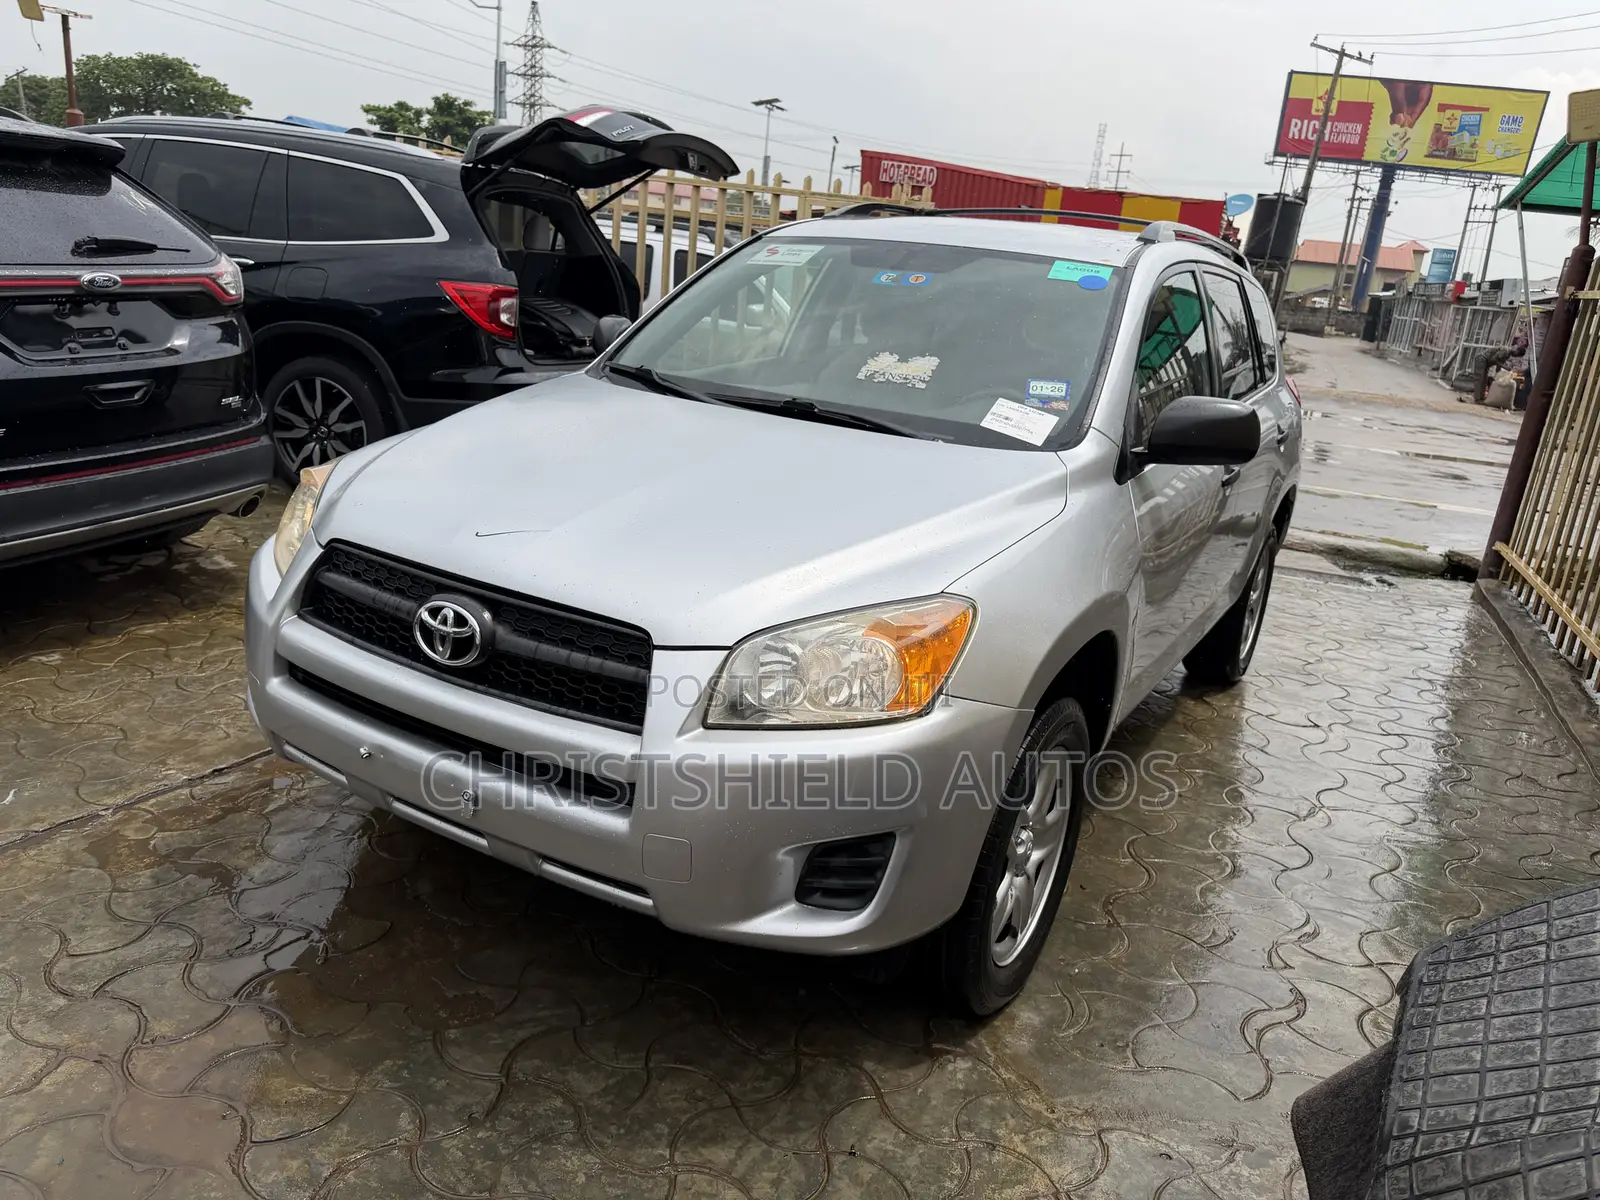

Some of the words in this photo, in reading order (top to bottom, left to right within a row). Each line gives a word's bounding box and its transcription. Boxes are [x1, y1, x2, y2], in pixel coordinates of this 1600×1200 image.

[611, 124, 634, 137] PILOT
[1288, 118, 1332, 142] RICH
[1332, 121, 1362, 135] CHICKEN
[1330, 131, 1361, 145] FLAVOUR
[93, 276, 114, 287] Ford
[1031, 384, 1044, 392] 01
[1050, 385, 1064, 393] 26
